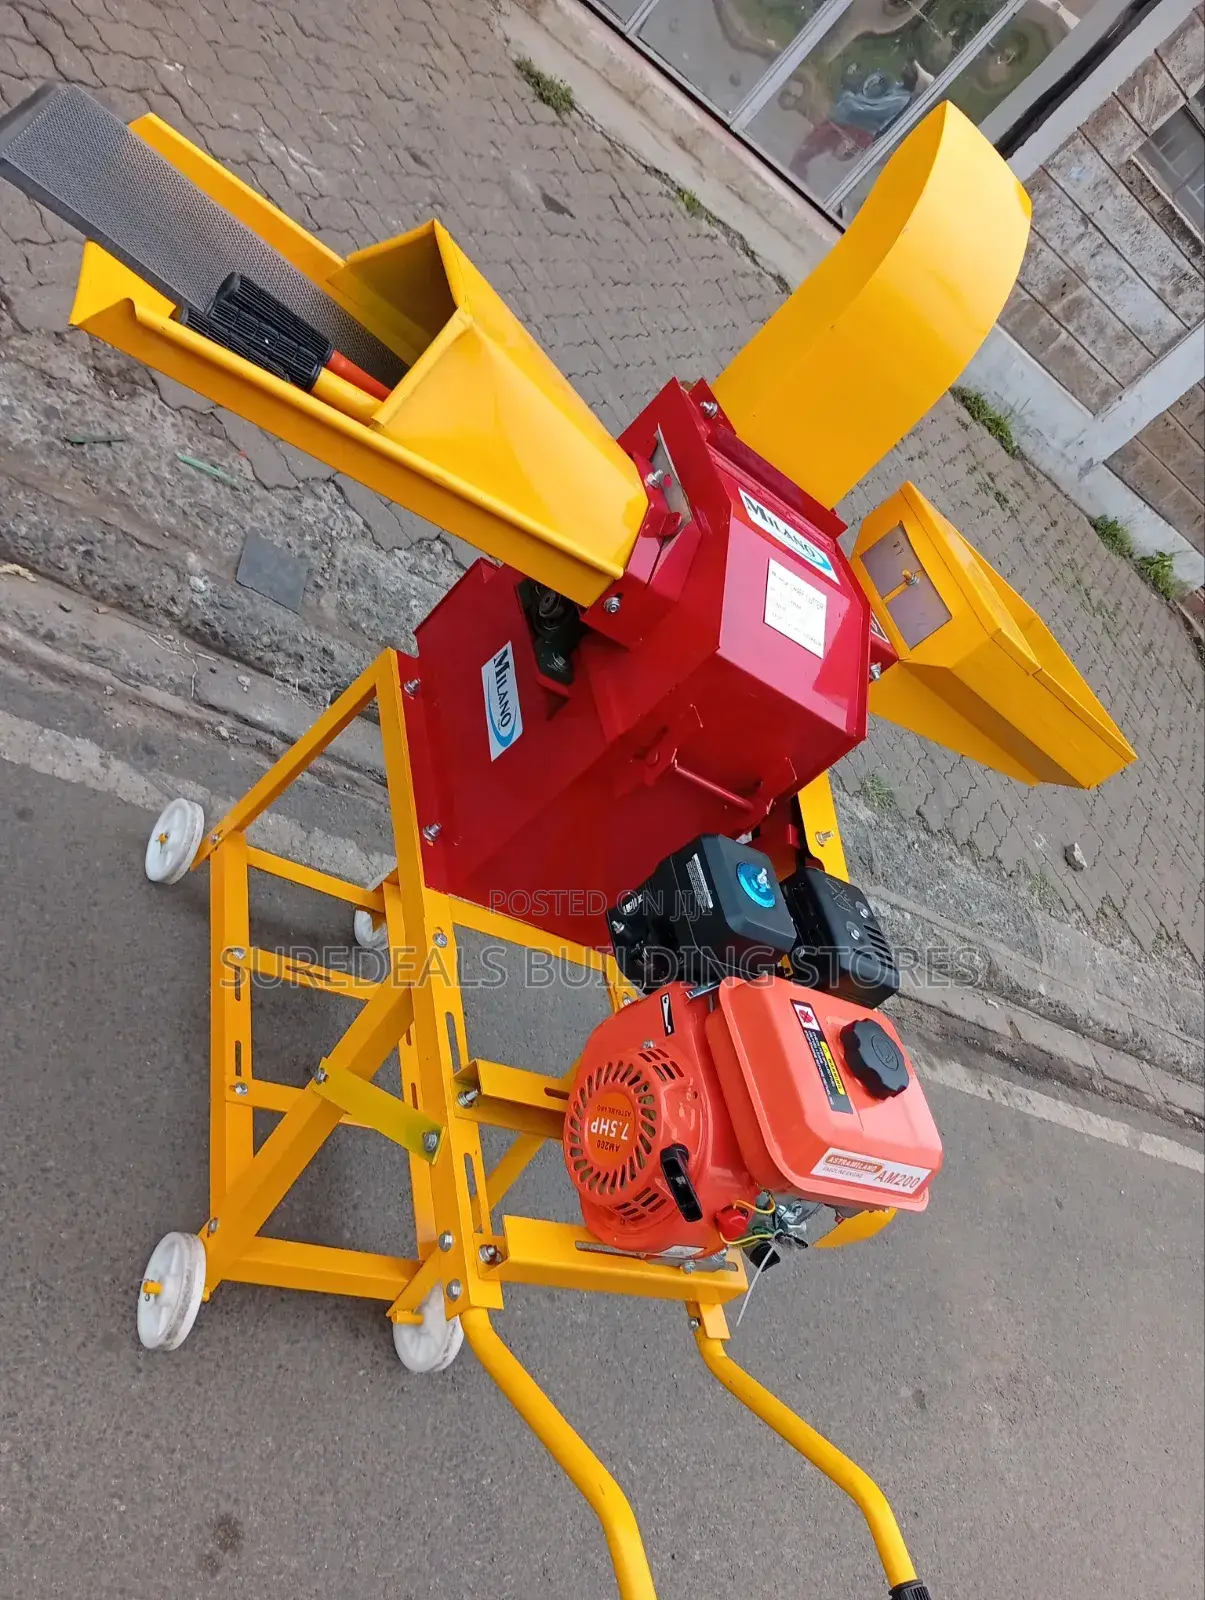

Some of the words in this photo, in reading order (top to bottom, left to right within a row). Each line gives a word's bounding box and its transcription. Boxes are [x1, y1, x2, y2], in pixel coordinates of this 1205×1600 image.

[743, 495, 816, 558] MILANO
[493, 647, 512, 728] MILANO
[590, 1116, 629, 1140] 7.5HP
[596, 1140, 620, 1153] AM200
[828, 1156, 878, 1173] ASTRAMILANO
[874, 1170, 921, 1189] AM200
